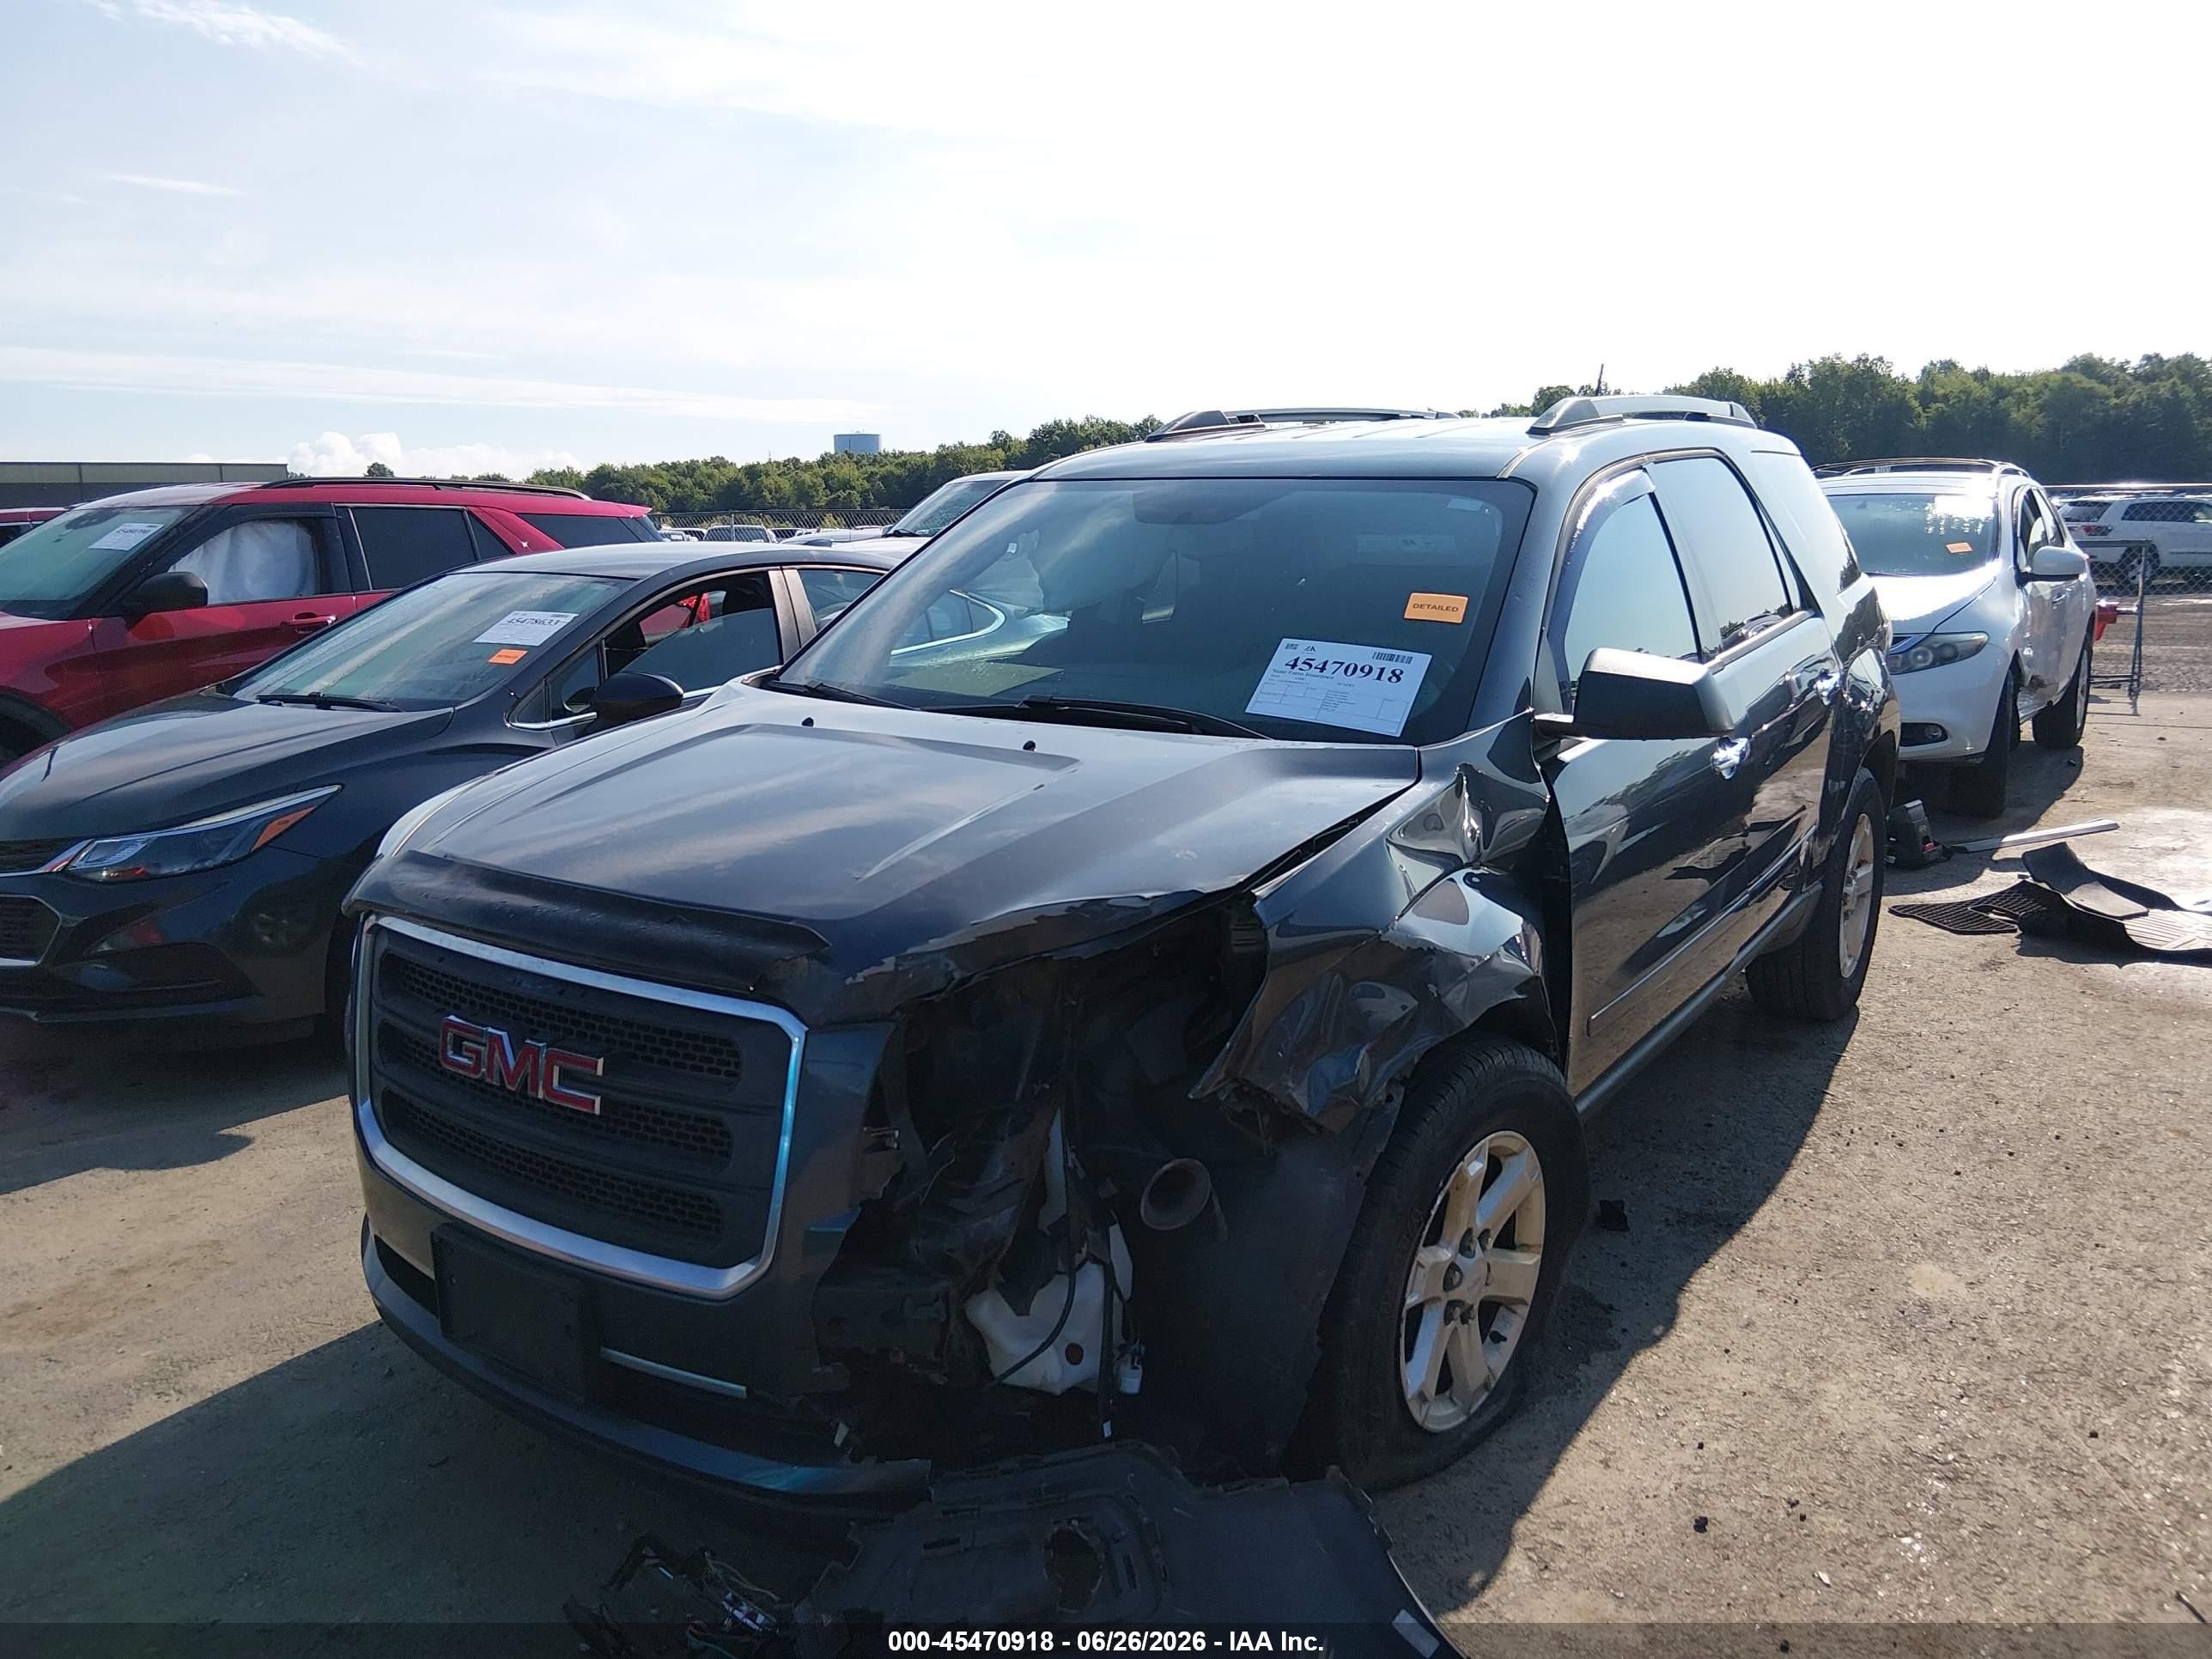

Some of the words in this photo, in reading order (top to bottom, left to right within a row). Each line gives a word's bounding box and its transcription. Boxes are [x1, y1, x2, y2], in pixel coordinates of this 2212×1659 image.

[1412, 603, 1459, 612] DETAILED
[1285, 656, 1405, 684] 45470918
[441, 1015, 604, 1115] GMC
